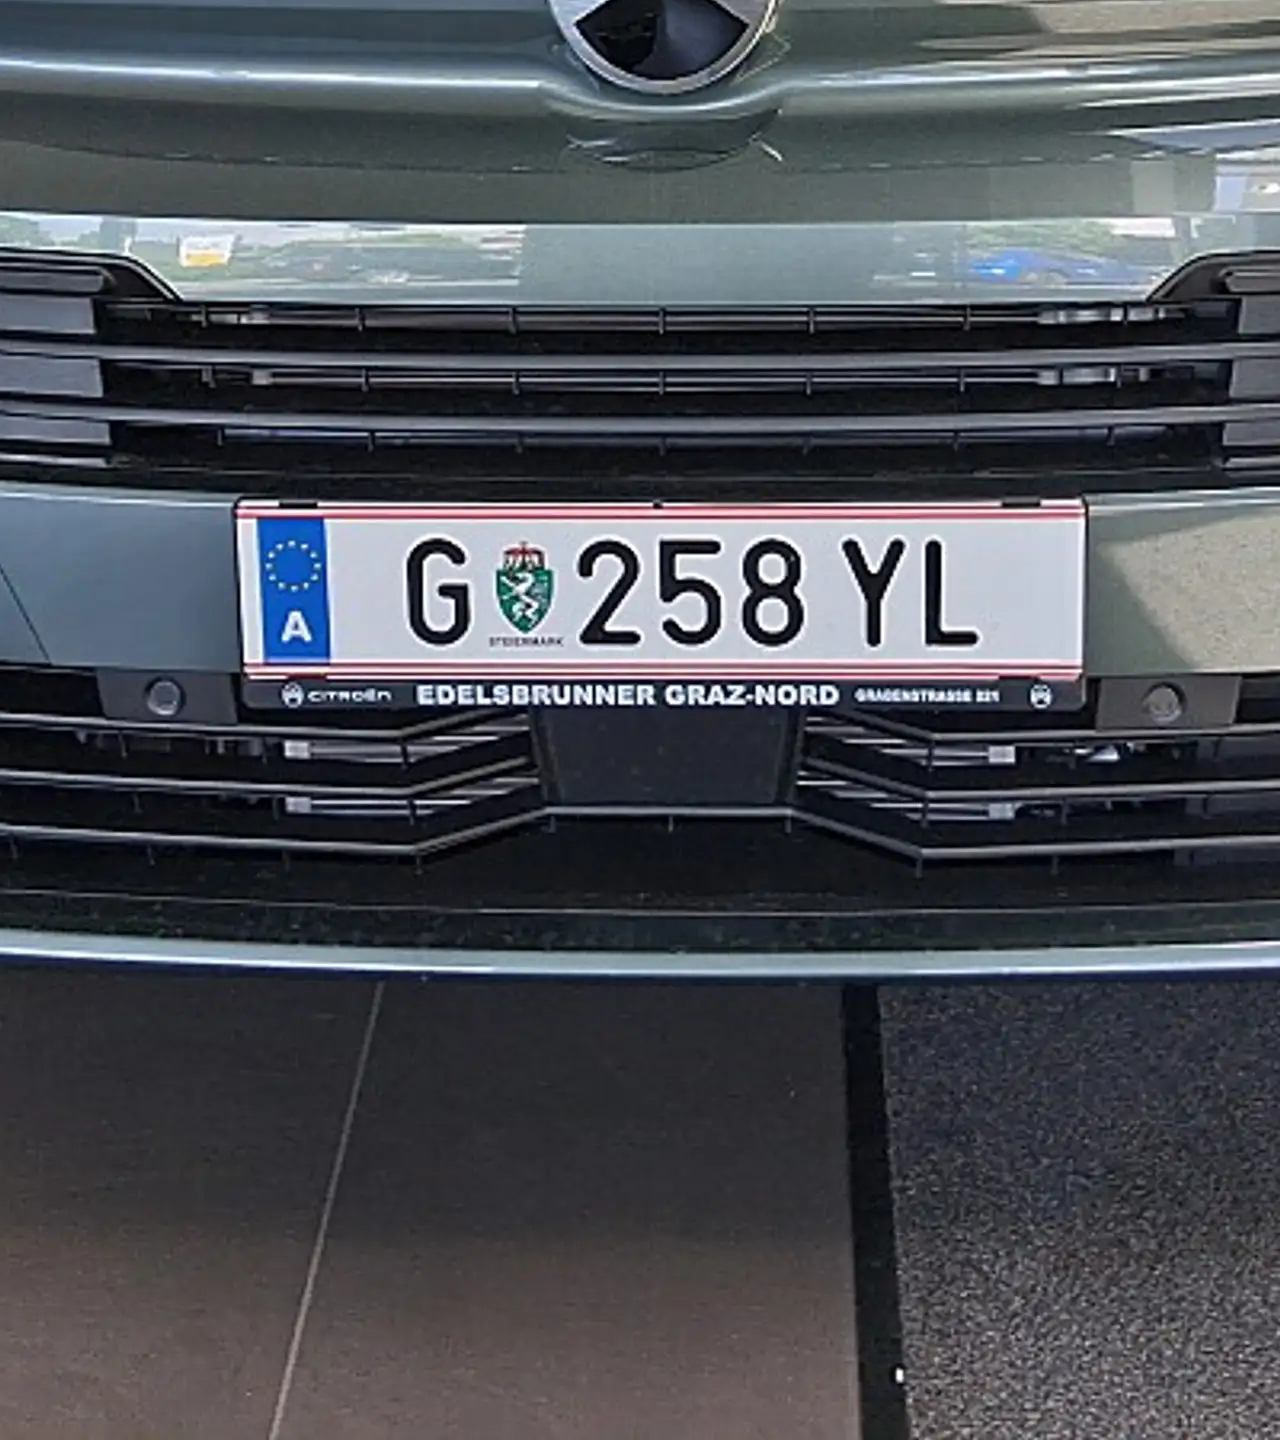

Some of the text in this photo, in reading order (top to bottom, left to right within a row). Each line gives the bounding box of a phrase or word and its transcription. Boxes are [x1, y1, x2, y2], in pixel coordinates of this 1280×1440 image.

[406, 538, 980, 647] G 258 YL
[280, 611, 312, 642] A
[417, 684, 840, 706] EDELSBRUNNER GRAZ-NORD
